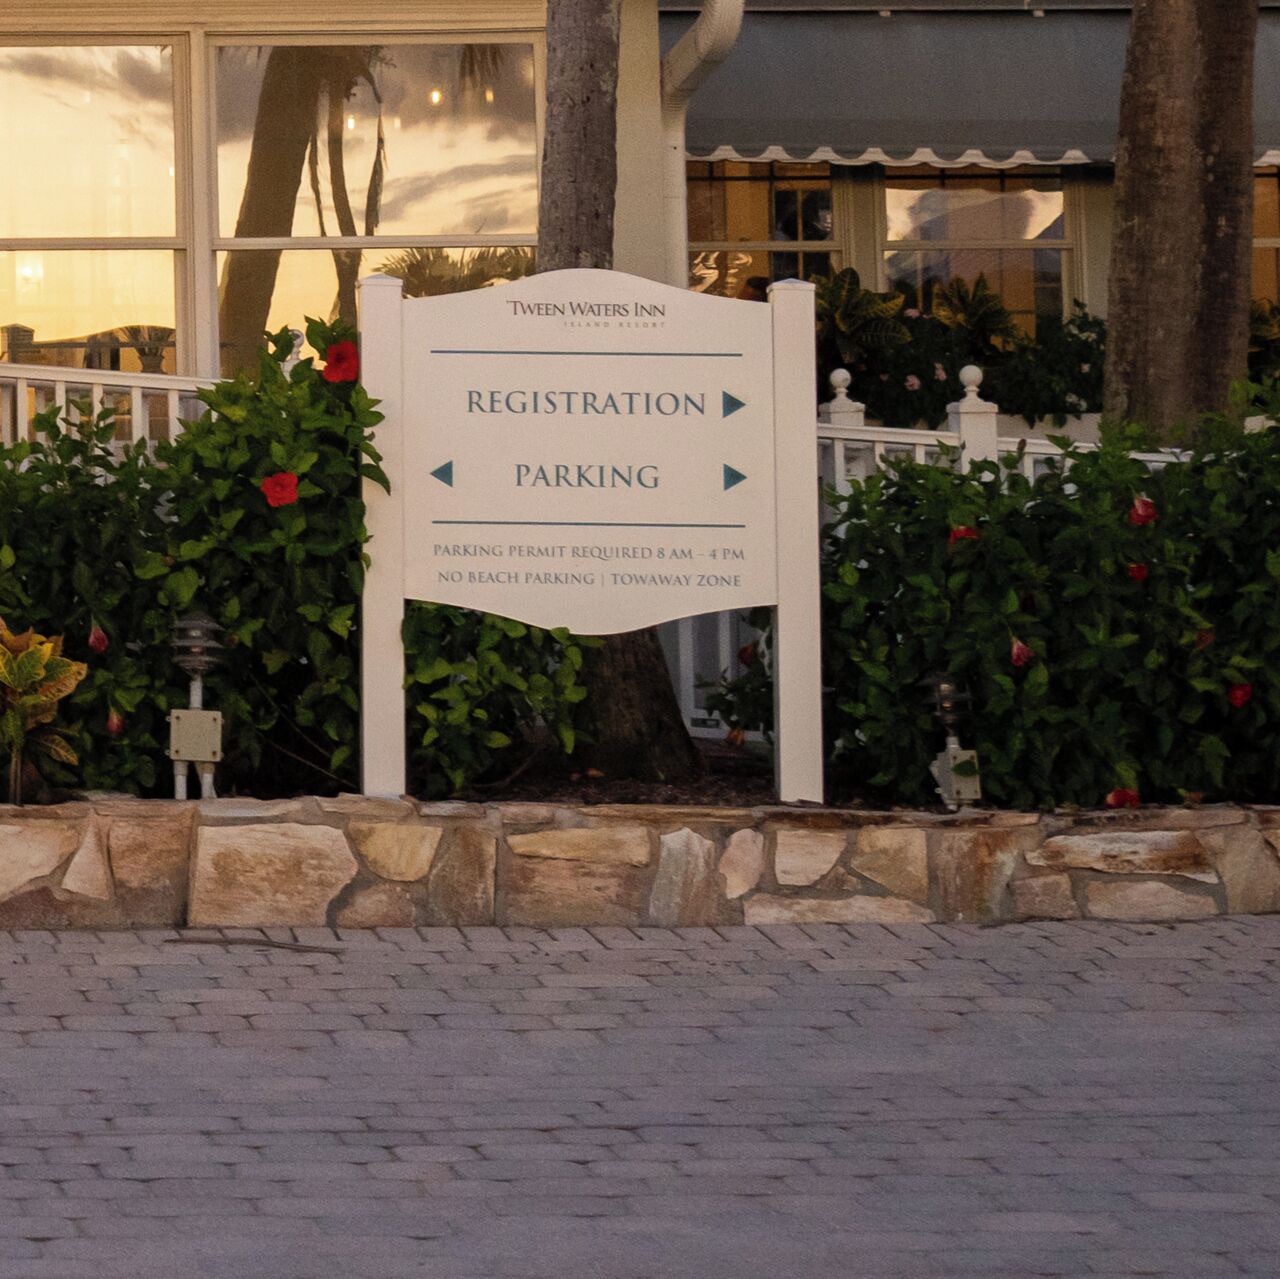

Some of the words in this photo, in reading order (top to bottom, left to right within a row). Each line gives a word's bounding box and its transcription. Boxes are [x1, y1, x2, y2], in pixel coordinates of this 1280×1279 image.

[569, 301, 629, 317] WATERS
[634, 302, 665, 317] INN
[466, 390, 706, 416] REGISTRATION
[515, 464, 660, 488] PARKING
[433, 544, 503, 557] PARKING
[508, 545, 566, 558] PERMIT
[571, 546, 652, 561] REQUIRED
[657, 547, 665, 559] 8
[669, 549, 693, 560] AM
[709, 549, 717, 560] 4
[722, 549, 745, 561] PM
[438, 571, 463, 584] NO
[468, 572, 519, 584] BEACH
[525, 572, 595, 585] PARKING
[610, 573, 693, 586] TOWAWAY
[697, 575, 741, 587] ZONE
